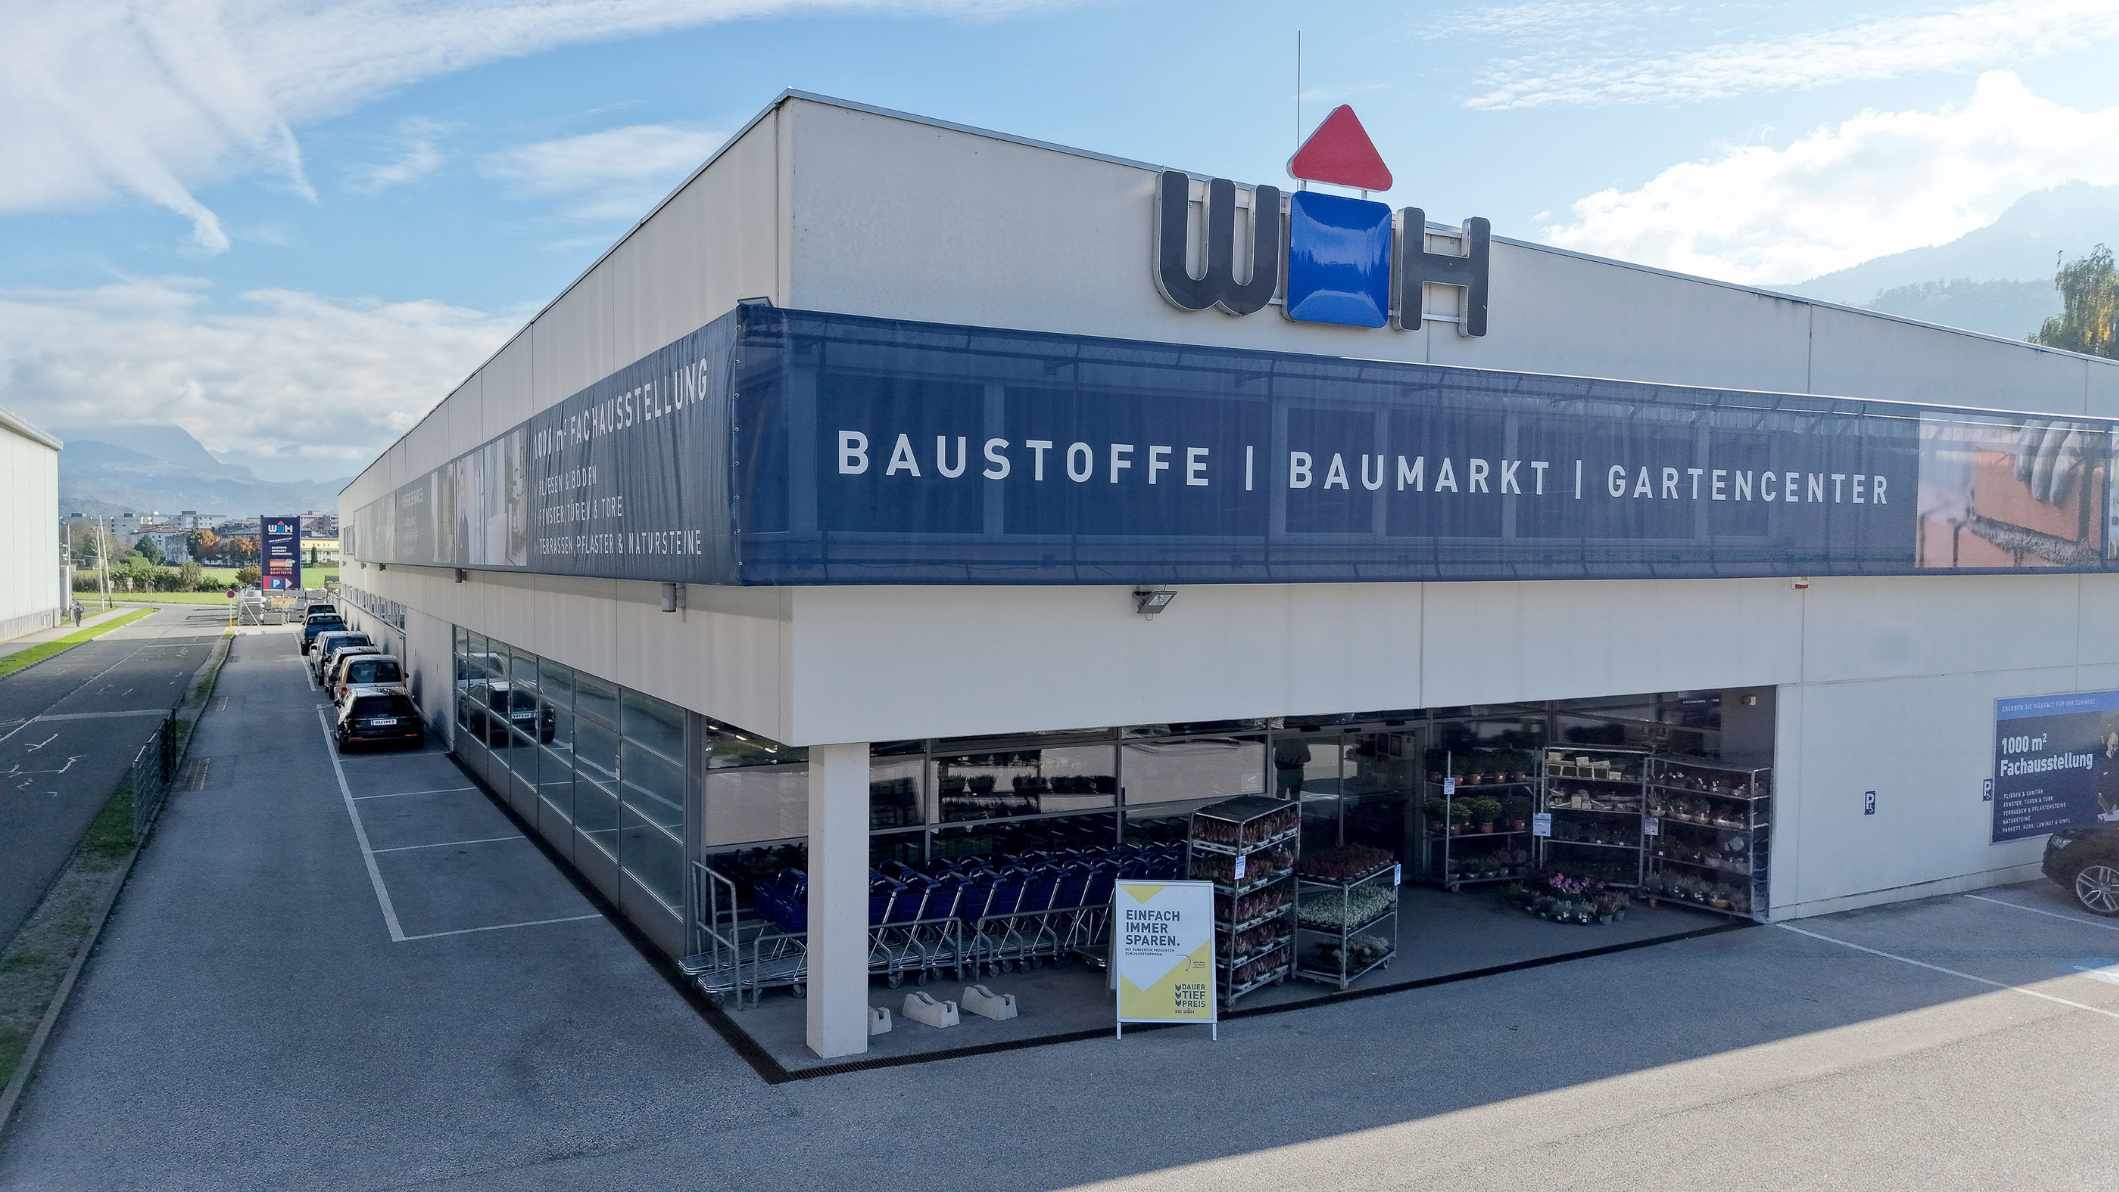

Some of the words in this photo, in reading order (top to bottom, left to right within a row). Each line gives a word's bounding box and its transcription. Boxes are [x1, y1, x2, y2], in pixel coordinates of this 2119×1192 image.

[571, 358, 707, 447] FACHAUSSTELLUNG
[838, 430, 1209, 486] BAUSTOFFE
[1289, 451, 1550, 496] BAUMARKT
[1607, 464, 1888, 505] GARTENCENTER
[572, 465, 597, 489] BÖDEN
[601, 496, 623, 518] TORE
[540, 536, 575, 557] TERRASSEN,
[576, 534, 614, 555] PFLASTER
[618, 533, 624, 555] &
[628, 529, 702, 555] NATURSTEINE
[273, 579, 280, 588] P
[2002, 705, 2023, 713] ERLEBEN
[2002, 735, 2029, 755] 1000
[2031, 732, 2048, 752] m²
[2000, 752, 2094, 777] Fachausstellung
[1866, 793, 1875, 810] P
[1126, 909, 1180, 922] EINFACH
[1126, 922, 1168, 934] IMMER
[1125, 934, 1180, 947] SPAREN.
[1182, 983, 1206, 991] DAUER
[1182, 990, 1206, 1000] TIEF
[1182, 1000, 1206, 1008] PREIS
